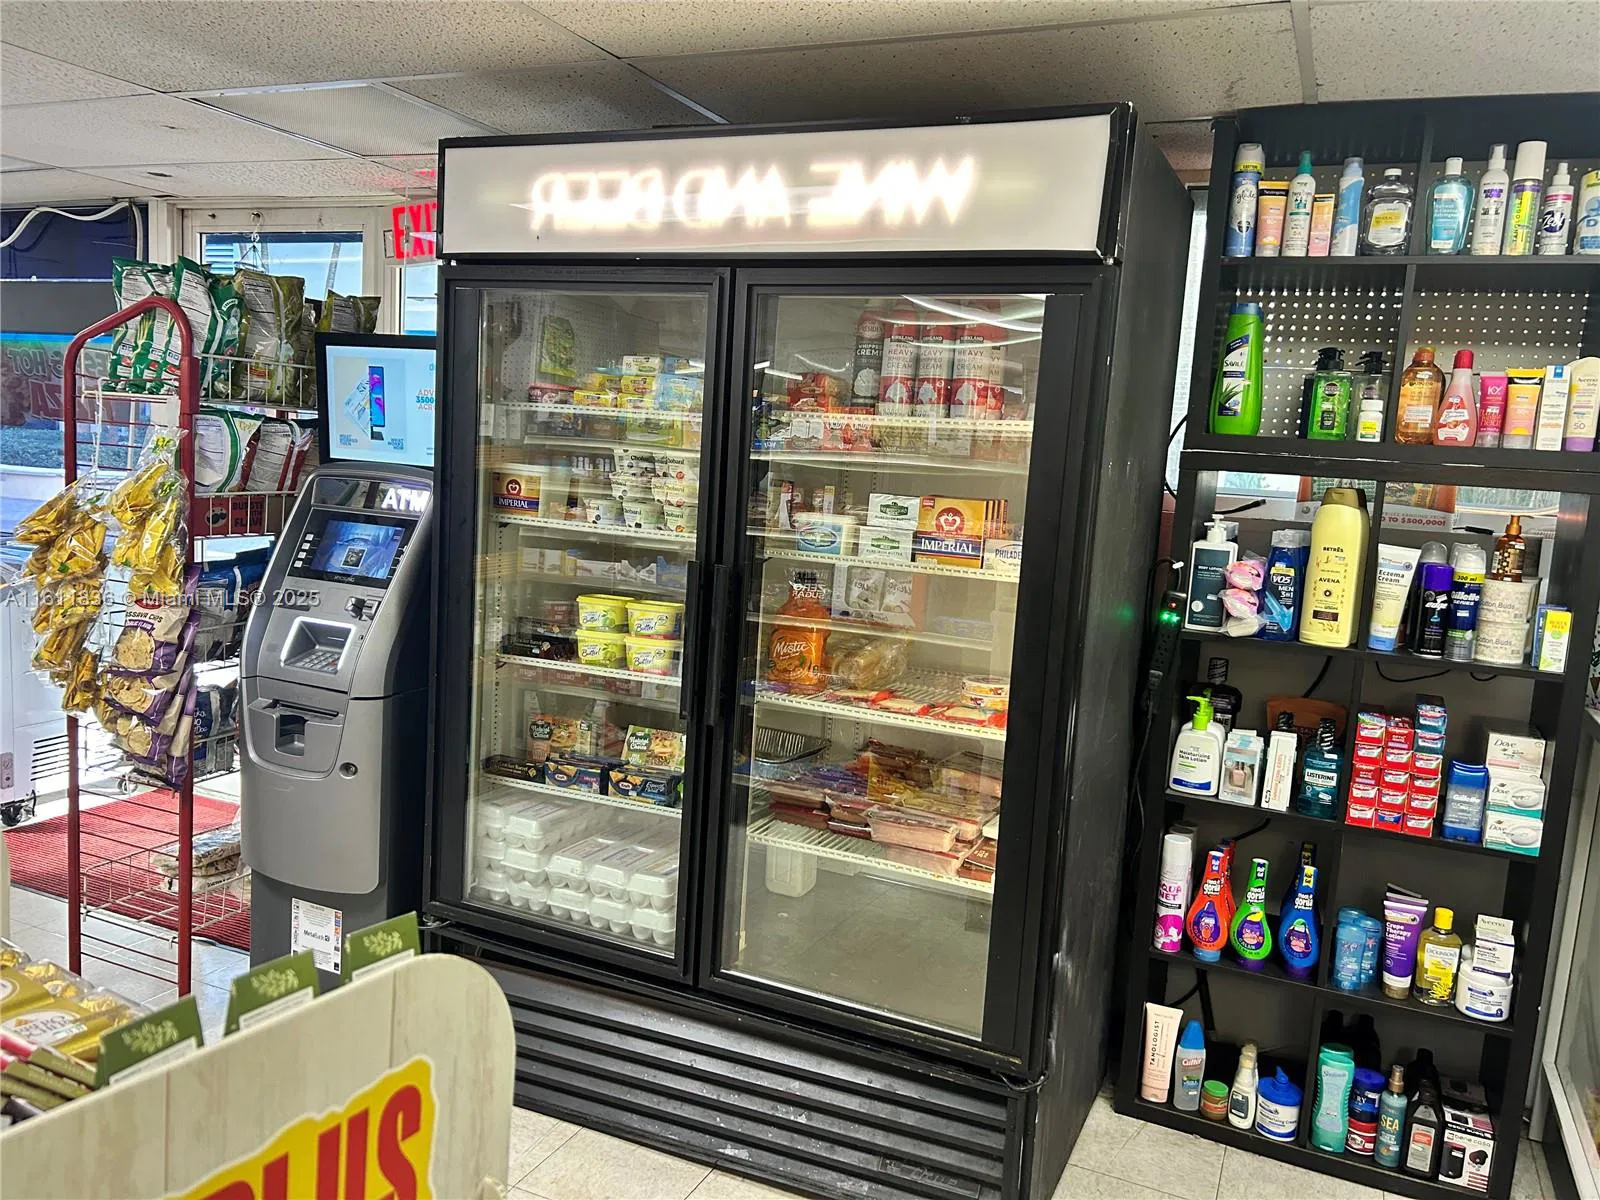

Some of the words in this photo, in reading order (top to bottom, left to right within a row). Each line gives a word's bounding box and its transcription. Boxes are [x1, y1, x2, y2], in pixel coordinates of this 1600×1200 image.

[956, 362, 984, 370] CREAM
[1573, 422, 1586, 430] 50
[381, 487, 430, 512] ATM
[498, 497, 529, 509] IMPERIAL
[1401, 517, 1446, 528] $500,000!
[921, 537, 974, 554] IMPERIAL
[1378, 570, 1405, 578] Eczema
[1271, 575, 1291, 584] VO5
[1499, 602, 1515, 610] Buds
[635, 621, 657, 633] Butter!
[581, 647, 602, 658] Butter!
[773, 640, 810, 658] Mistic
[633, 655, 656, 667] Butter!
[1493, 739, 1517, 748] Dove
[1179, 749, 1211, 760] Moisturizing
[1306, 771, 1336, 781] LISTERINE
[1492, 787, 1510, 795] Dove
[1489, 823, 1508, 832] Dove
[1386, 922, 1405, 930] Crepe
[1386, 927, 1412, 937] Therapy
[1386, 932, 1406, 941] Lotion
[1149, 1020, 1160, 1066] TANOLOGIST
[1381, 1114, 1400, 1131] SEA
[1454, 1134, 1472, 1143] bene
[1473, 1139, 1491, 1148] casa
